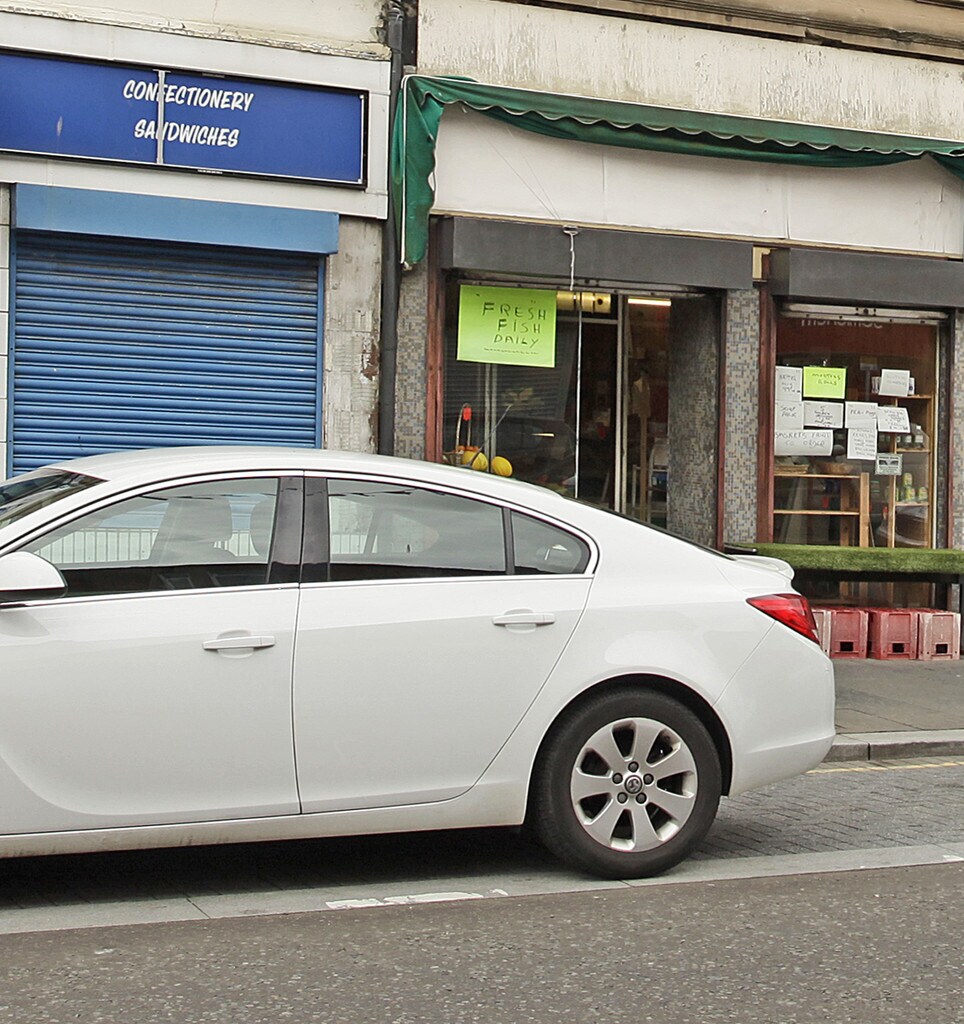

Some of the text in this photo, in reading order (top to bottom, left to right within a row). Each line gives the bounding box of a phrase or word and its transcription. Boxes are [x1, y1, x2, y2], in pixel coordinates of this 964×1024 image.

[123, 80, 254, 111] CONFECTIONERY
[134, 119, 240, 147] SANDWICHES
[482, 301, 547, 321] FRESH
[498, 318, 541, 334] FISH
[494, 333, 540, 349] DAILY
